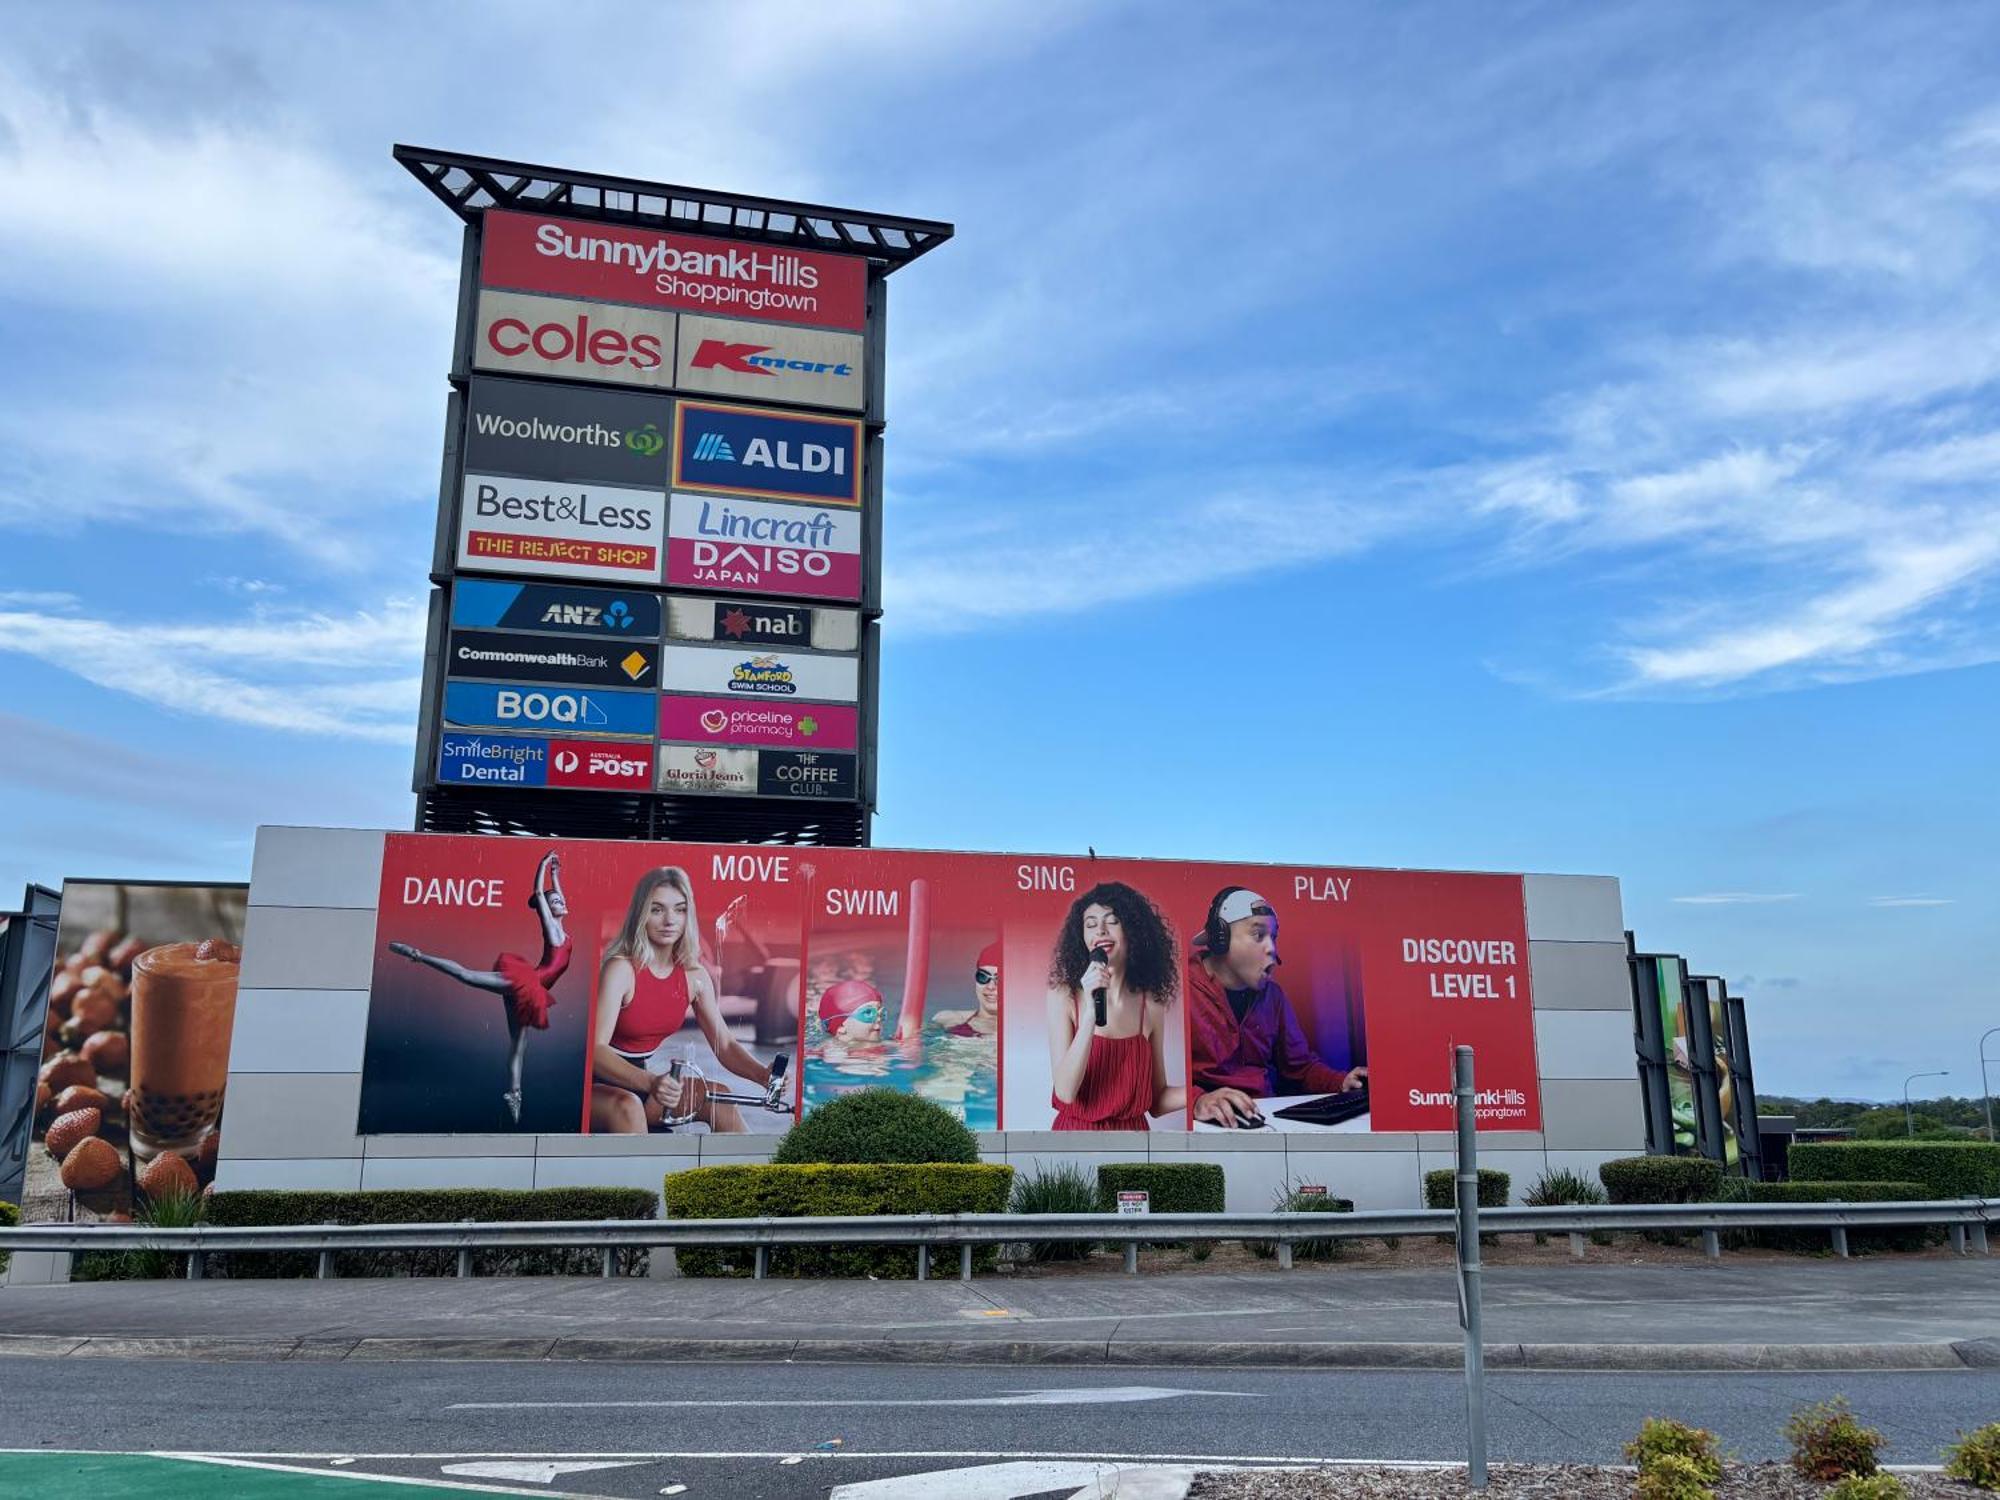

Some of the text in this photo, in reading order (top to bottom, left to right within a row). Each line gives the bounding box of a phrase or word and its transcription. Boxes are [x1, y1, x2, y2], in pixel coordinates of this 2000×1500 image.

[536, 223, 818, 289] SunnybankHills
[655, 274, 817, 312] Shoppingtown
[488, 315, 662, 370] coles
[690, 339, 853, 376] Kmart
[476, 413, 621, 448] Woolworths
[741, 438, 845, 475] ALDI
[476, 484, 652, 531] Best&Less
[698, 501, 837, 548] Lincraft
[476, 537, 648, 565] THE REJECT SHOP
[693, 541, 832, 577] DAISO
[693, 568, 760, 584] JAPAN
[540, 603, 603, 626] ANZ
[755, 614, 803, 635] nab
[458, 646, 608, 668] CommonwealthBank
[731, 682, 793, 693] SWIM SCHOOL
[496, 691, 579, 723] BOQ
[731, 711, 793, 724] priceline
[730, 723, 793, 738] pharmacy
[444, 740, 544, 764] SmileBright
[795, 753, 820, 765] THE
[461, 763, 525, 781] Dental
[588, 758, 648, 777] POST
[667, 768, 745, 782] Gloria Jean's
[776, 765, 838, 782] COFFEE
[790, 783, 823, 796] CLUB
[712, 855, 789, 883] MOVE
[1017, 865, 1076, 891] SING
[403, 877, 504, 908] DANCE
[1294, 875, 1352, 901] PLAY
[826, 888, 899, 916] SWIM
[1402, 938, 1516, 965] DISCOVER
[1430, 974, 1516, 999] LEVEL 1
